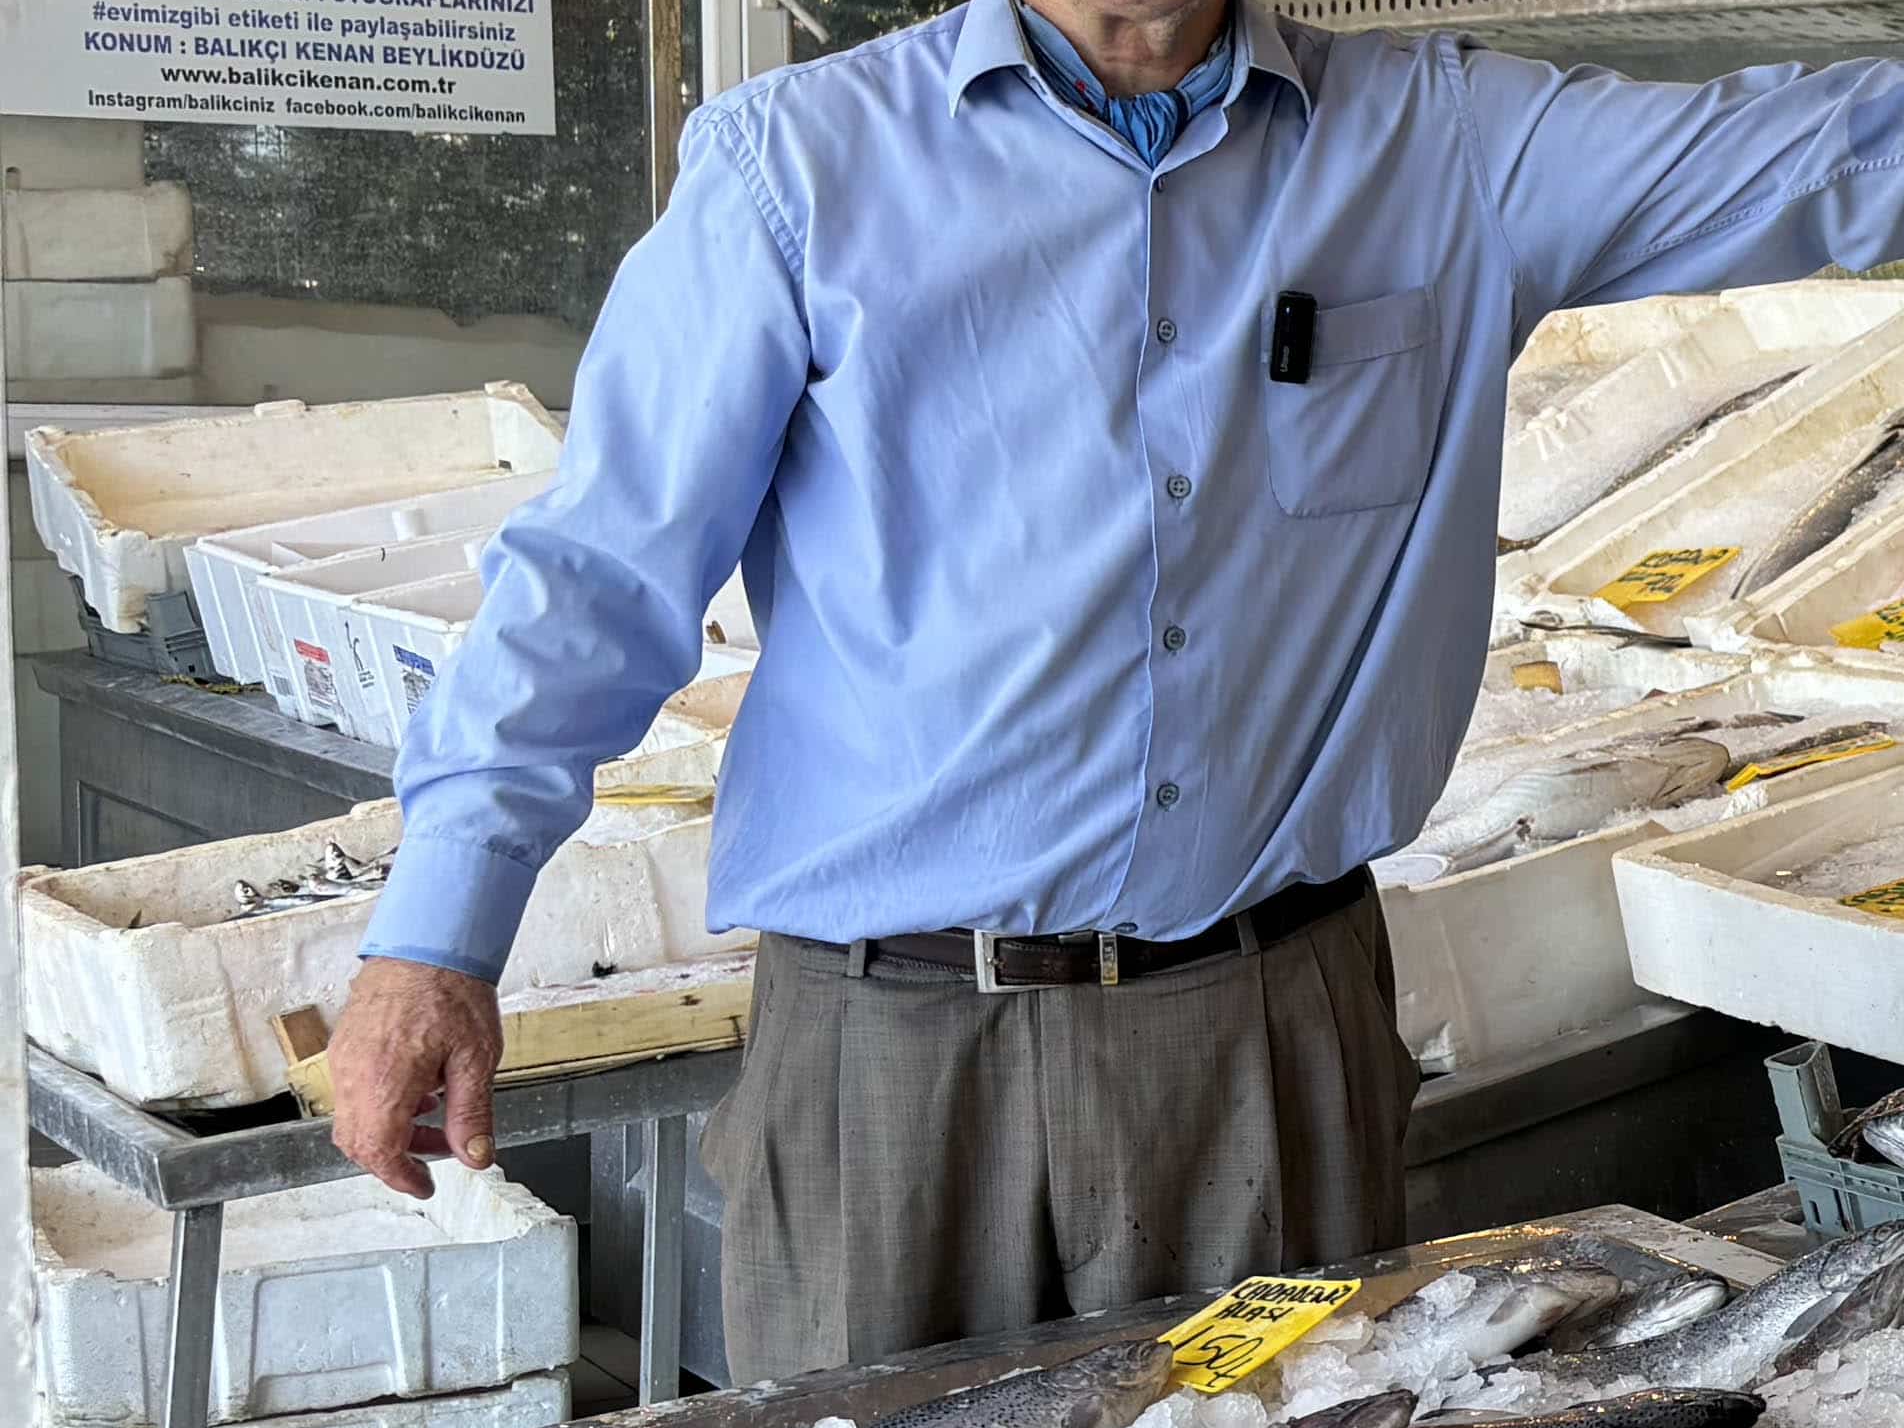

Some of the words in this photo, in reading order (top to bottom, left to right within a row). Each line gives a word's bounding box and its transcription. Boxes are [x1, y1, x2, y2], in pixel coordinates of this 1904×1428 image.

[92, 0, 221, 30] #evimizgibi
[228, 6, 299, 31] etiketi
[306, 10, 334, 32] ile
[340, 14, 517, 42] paylaşabilirsiniz
[84, 30, 174, 55] KONUM
[194, 37, 288, 61] BALIKÇI
[295, 41, 375, 63] KENAN
[382, 45, 525, 71] BEYLİKDÜZÜ
[161, 65, 457, 96] www.balikcikenan.com.tr
[88, 89, 275, 115] Instagram/balikciniz
[285, 97, 526, 125] facebook.com/balikcikenan
